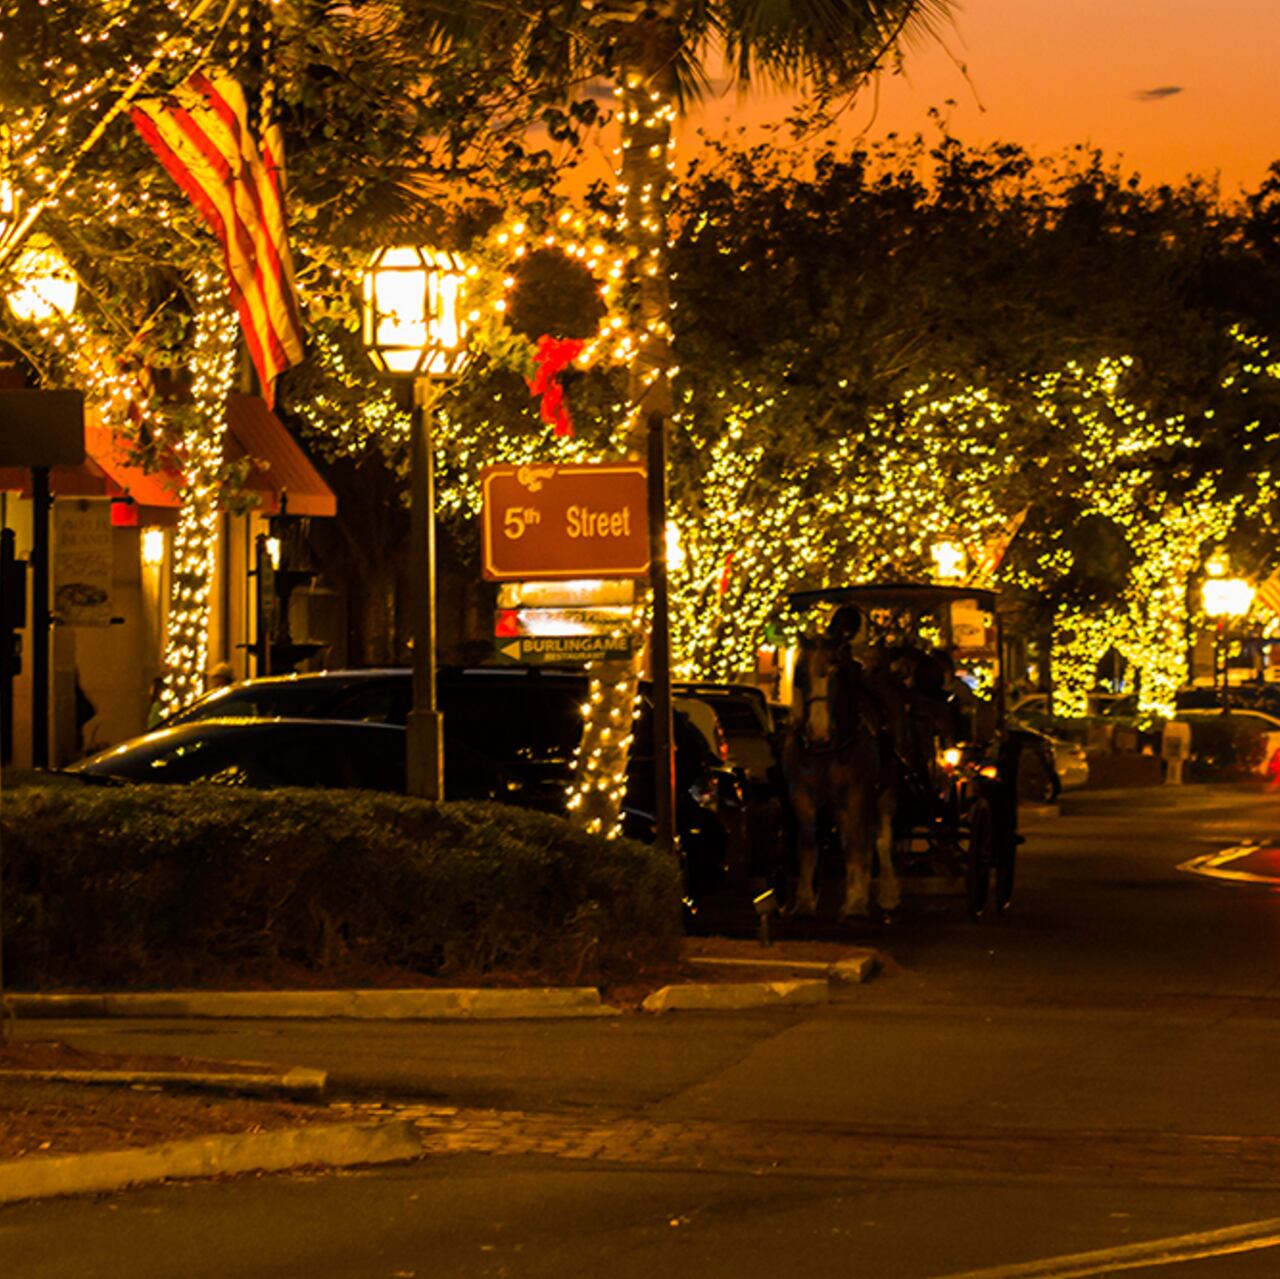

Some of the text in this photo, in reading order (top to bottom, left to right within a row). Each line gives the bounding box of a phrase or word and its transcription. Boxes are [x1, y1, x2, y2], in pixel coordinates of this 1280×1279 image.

[504, 504, 630, 539] 5th Street
[523, 638, 627, 652] BURLINGAME
